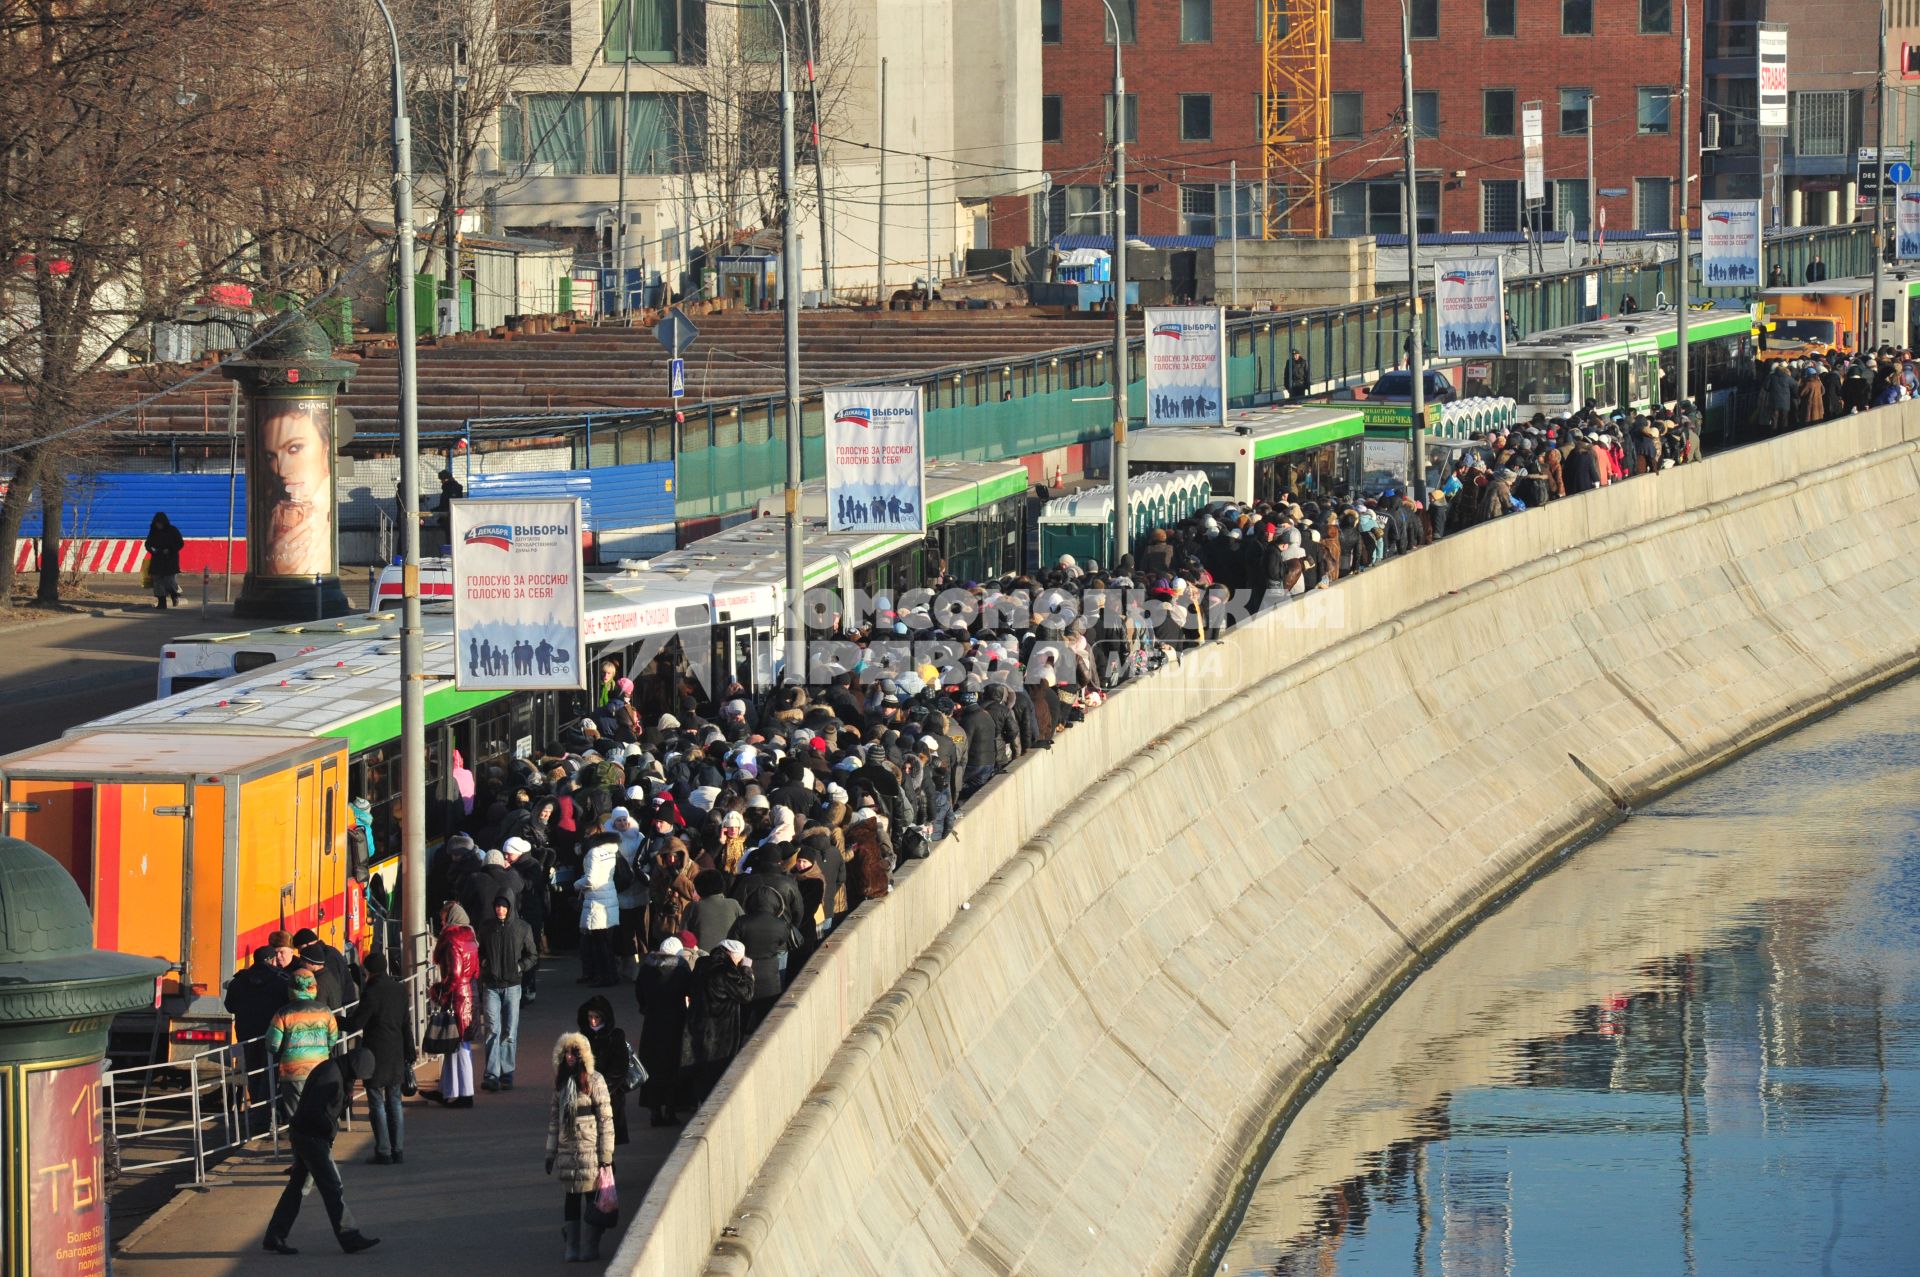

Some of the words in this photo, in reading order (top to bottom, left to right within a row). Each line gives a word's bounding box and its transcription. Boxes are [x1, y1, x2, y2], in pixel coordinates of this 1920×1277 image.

[1761, 66, 1786, 90] STRABAG
[1182, 323, 1217, 331] ВЫБОРЫ
[298, 402, 329, 410] CHANEL
[872, 408, 913, 417] ВЫБОРЫ
[836, 446, 869, 455] ГОЛОСУЮ
[871, 446, 880, 455] ЗА
[882, 445, 913, 455] РОССИЮ!
[836, 456, 869, 465] ГОЛОСУЮ
[871, 456, 880, 465] ЗА
[882, 456, 902, 465] СЕБЯ!
[468, 528, 477, 538] 4
[478, 527, 509, 537] ДЕКАБРЯ
[514, 524, 568, 536] ВЫБОРЫ
[467, 575, 511, 587] ГОЛОСУЮ
[513, 575, 525, 586] ЗА
[528, 574, 568, 585] РОССИЮ!
[467, 588, 511, 600] ГОЛОСУЮ
[513, 588, 526, 599] ЗА
[528, 587, 554, 599] СЕБЯ!
[67, 1231, 92, 1244] Более
